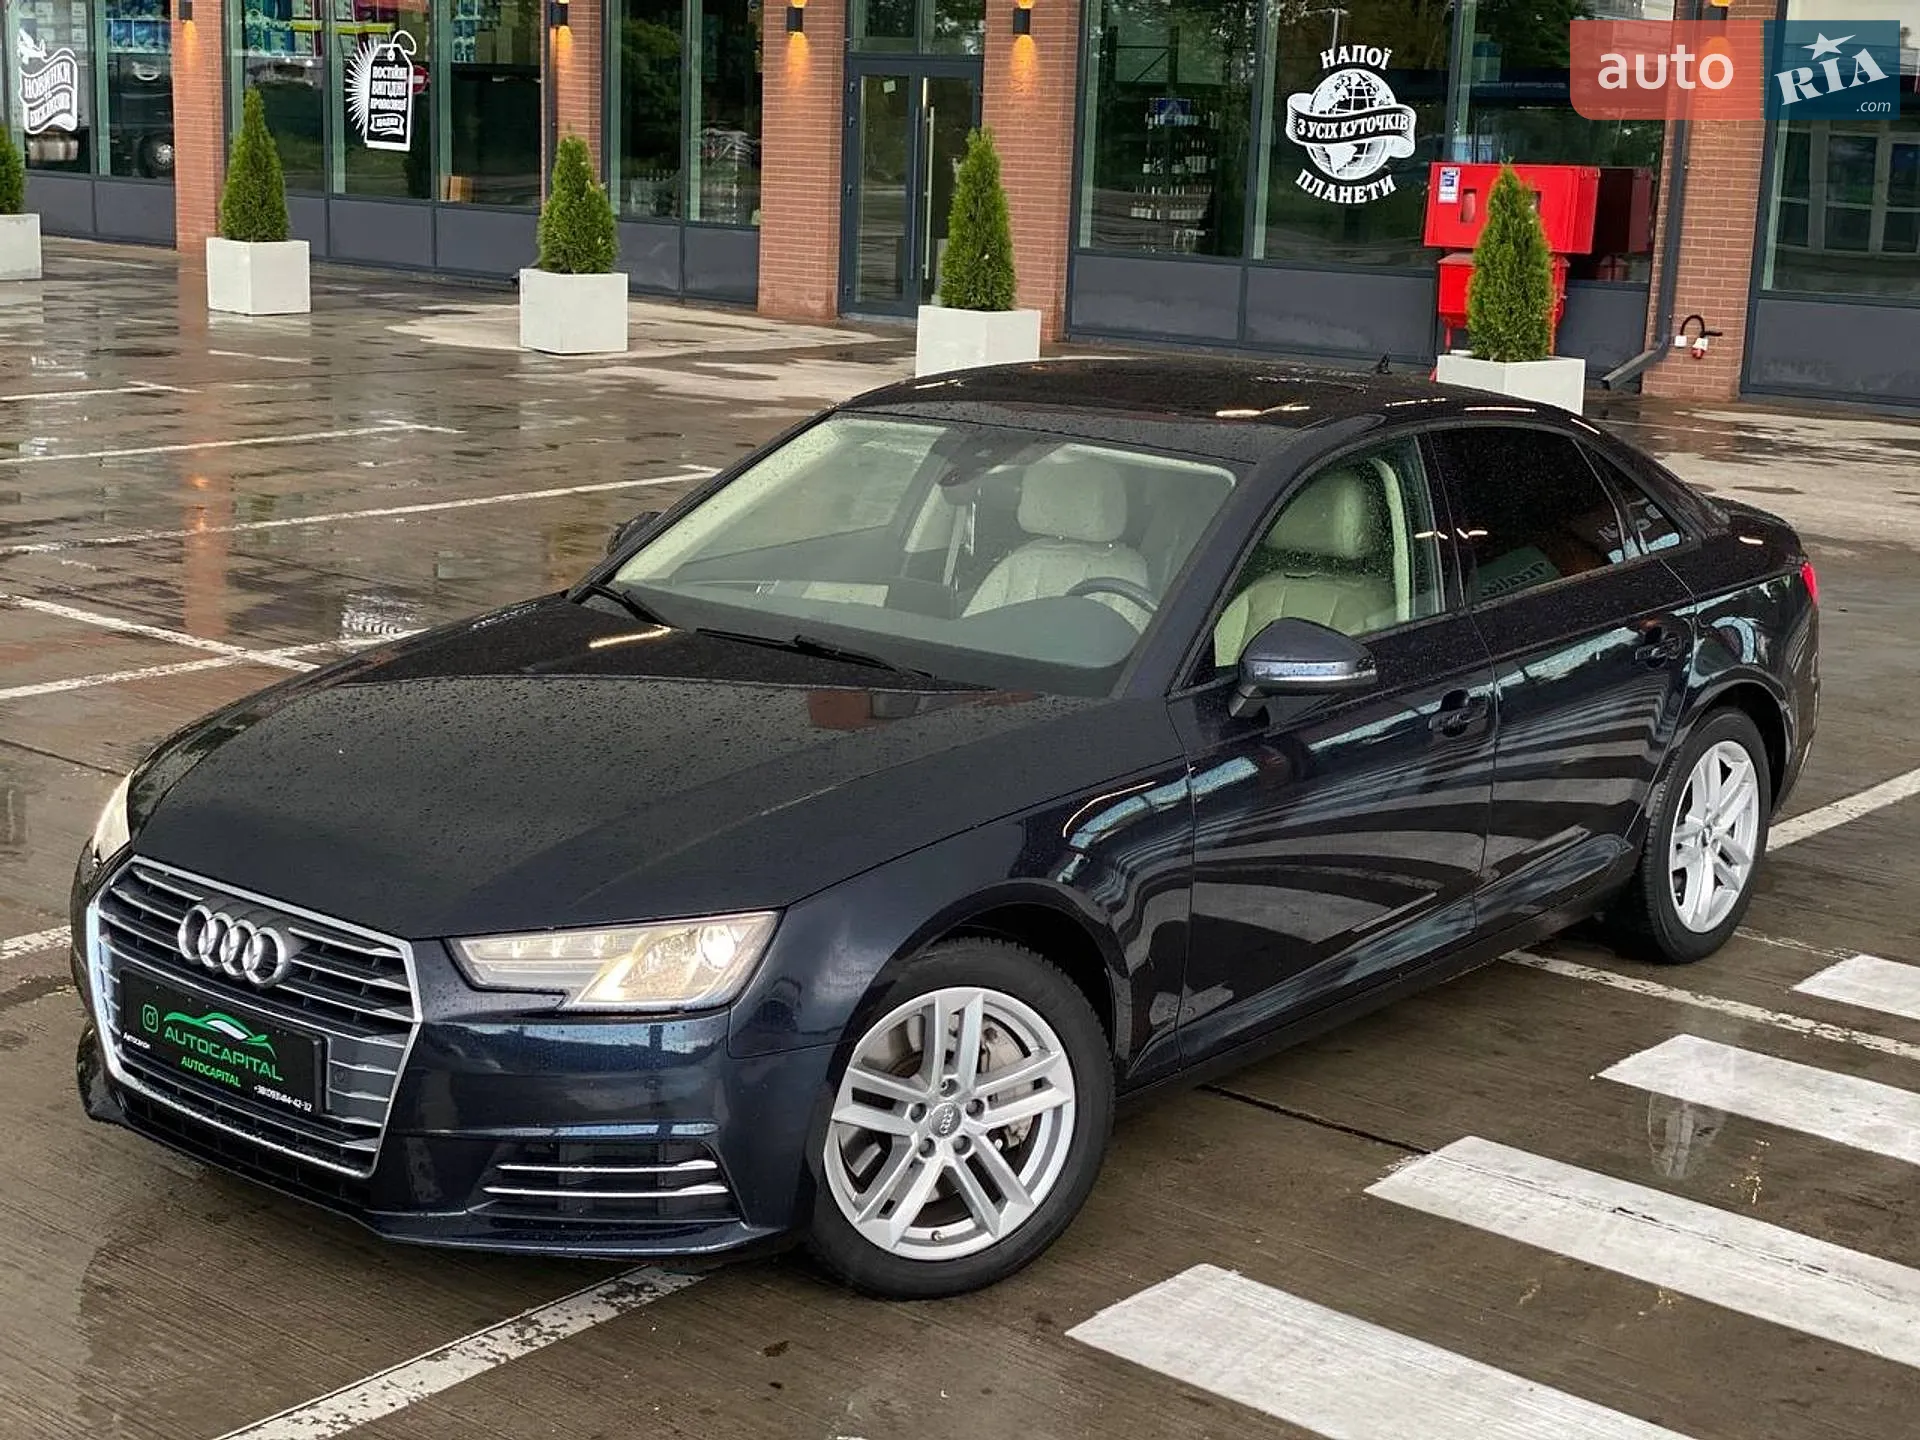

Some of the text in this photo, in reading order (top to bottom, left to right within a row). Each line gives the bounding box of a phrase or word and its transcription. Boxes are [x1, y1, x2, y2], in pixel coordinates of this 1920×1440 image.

[1319, 44, 1393, 71] НАПОЇ
[23, 61, 72, 99] НОВИНКИ
[1307, 120, 1339, 140] УСІХ
[1340, 113, 1409, 138] КУТОЧКІВ
[1295, 168, 1398, 204] ПЛАНЕТИ
[164, 1025, 284, 1082] AUTOCAPITAL
[181, 1055, 242, 1088] AUTOCAPITAL
